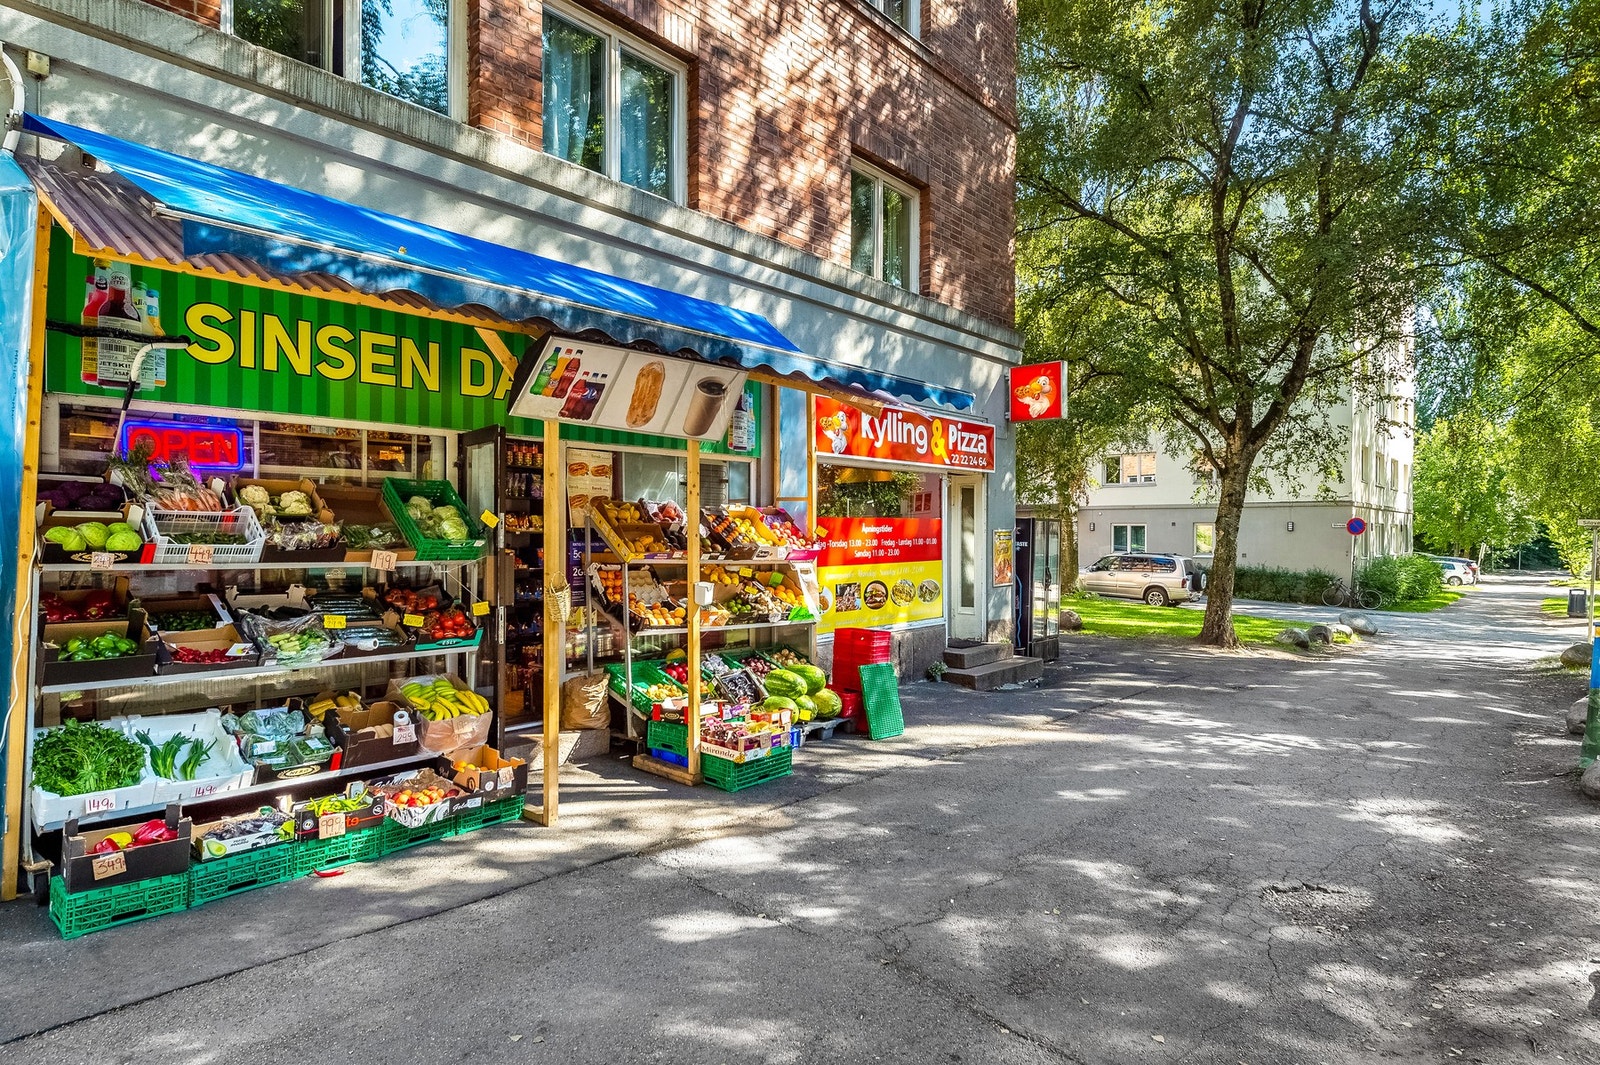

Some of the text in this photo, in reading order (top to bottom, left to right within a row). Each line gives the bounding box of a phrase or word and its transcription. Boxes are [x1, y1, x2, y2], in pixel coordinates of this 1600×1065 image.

[184, 301, 441, 392] SINSEN
[128, 427, 239, 464] OPEN
[861, 411, 988, 465] Kylling & Pizza
[951, 454, 988, 467] 22 22 24 64
[866, 539, 878, 547] 23.00
[881, 538, 895, 548] Fredag
[887, 548, 900, 556] 23.00
[701, 745, 735, 760] Miranda
